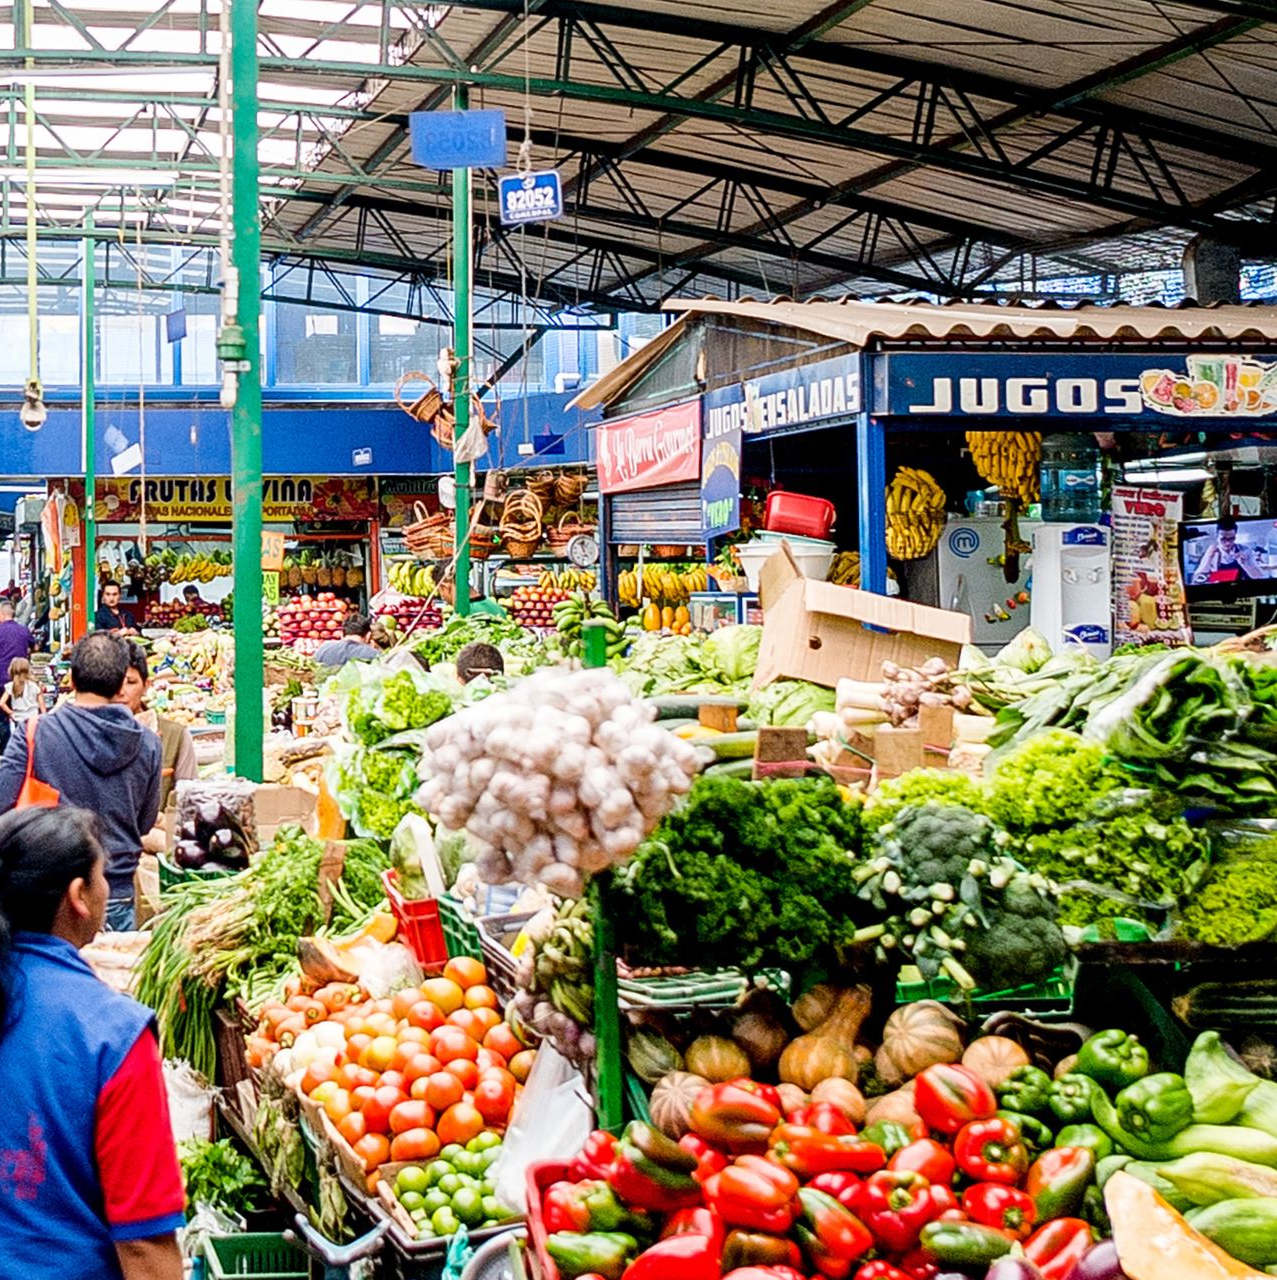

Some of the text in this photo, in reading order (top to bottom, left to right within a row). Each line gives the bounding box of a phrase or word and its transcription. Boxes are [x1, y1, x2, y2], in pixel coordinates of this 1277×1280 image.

[506, 186, 554, 211] 82052
[909, 377, 1144, 414] JUGOS
[705, 401, 749, 440] JUGOS
[129, 478, 218, 504] FRUTAS
[262, 473, 314, 504] VIÑA
[170, 506, 233, 518] NACIONALE
[262, 506, 314, 517] PORTADAS
